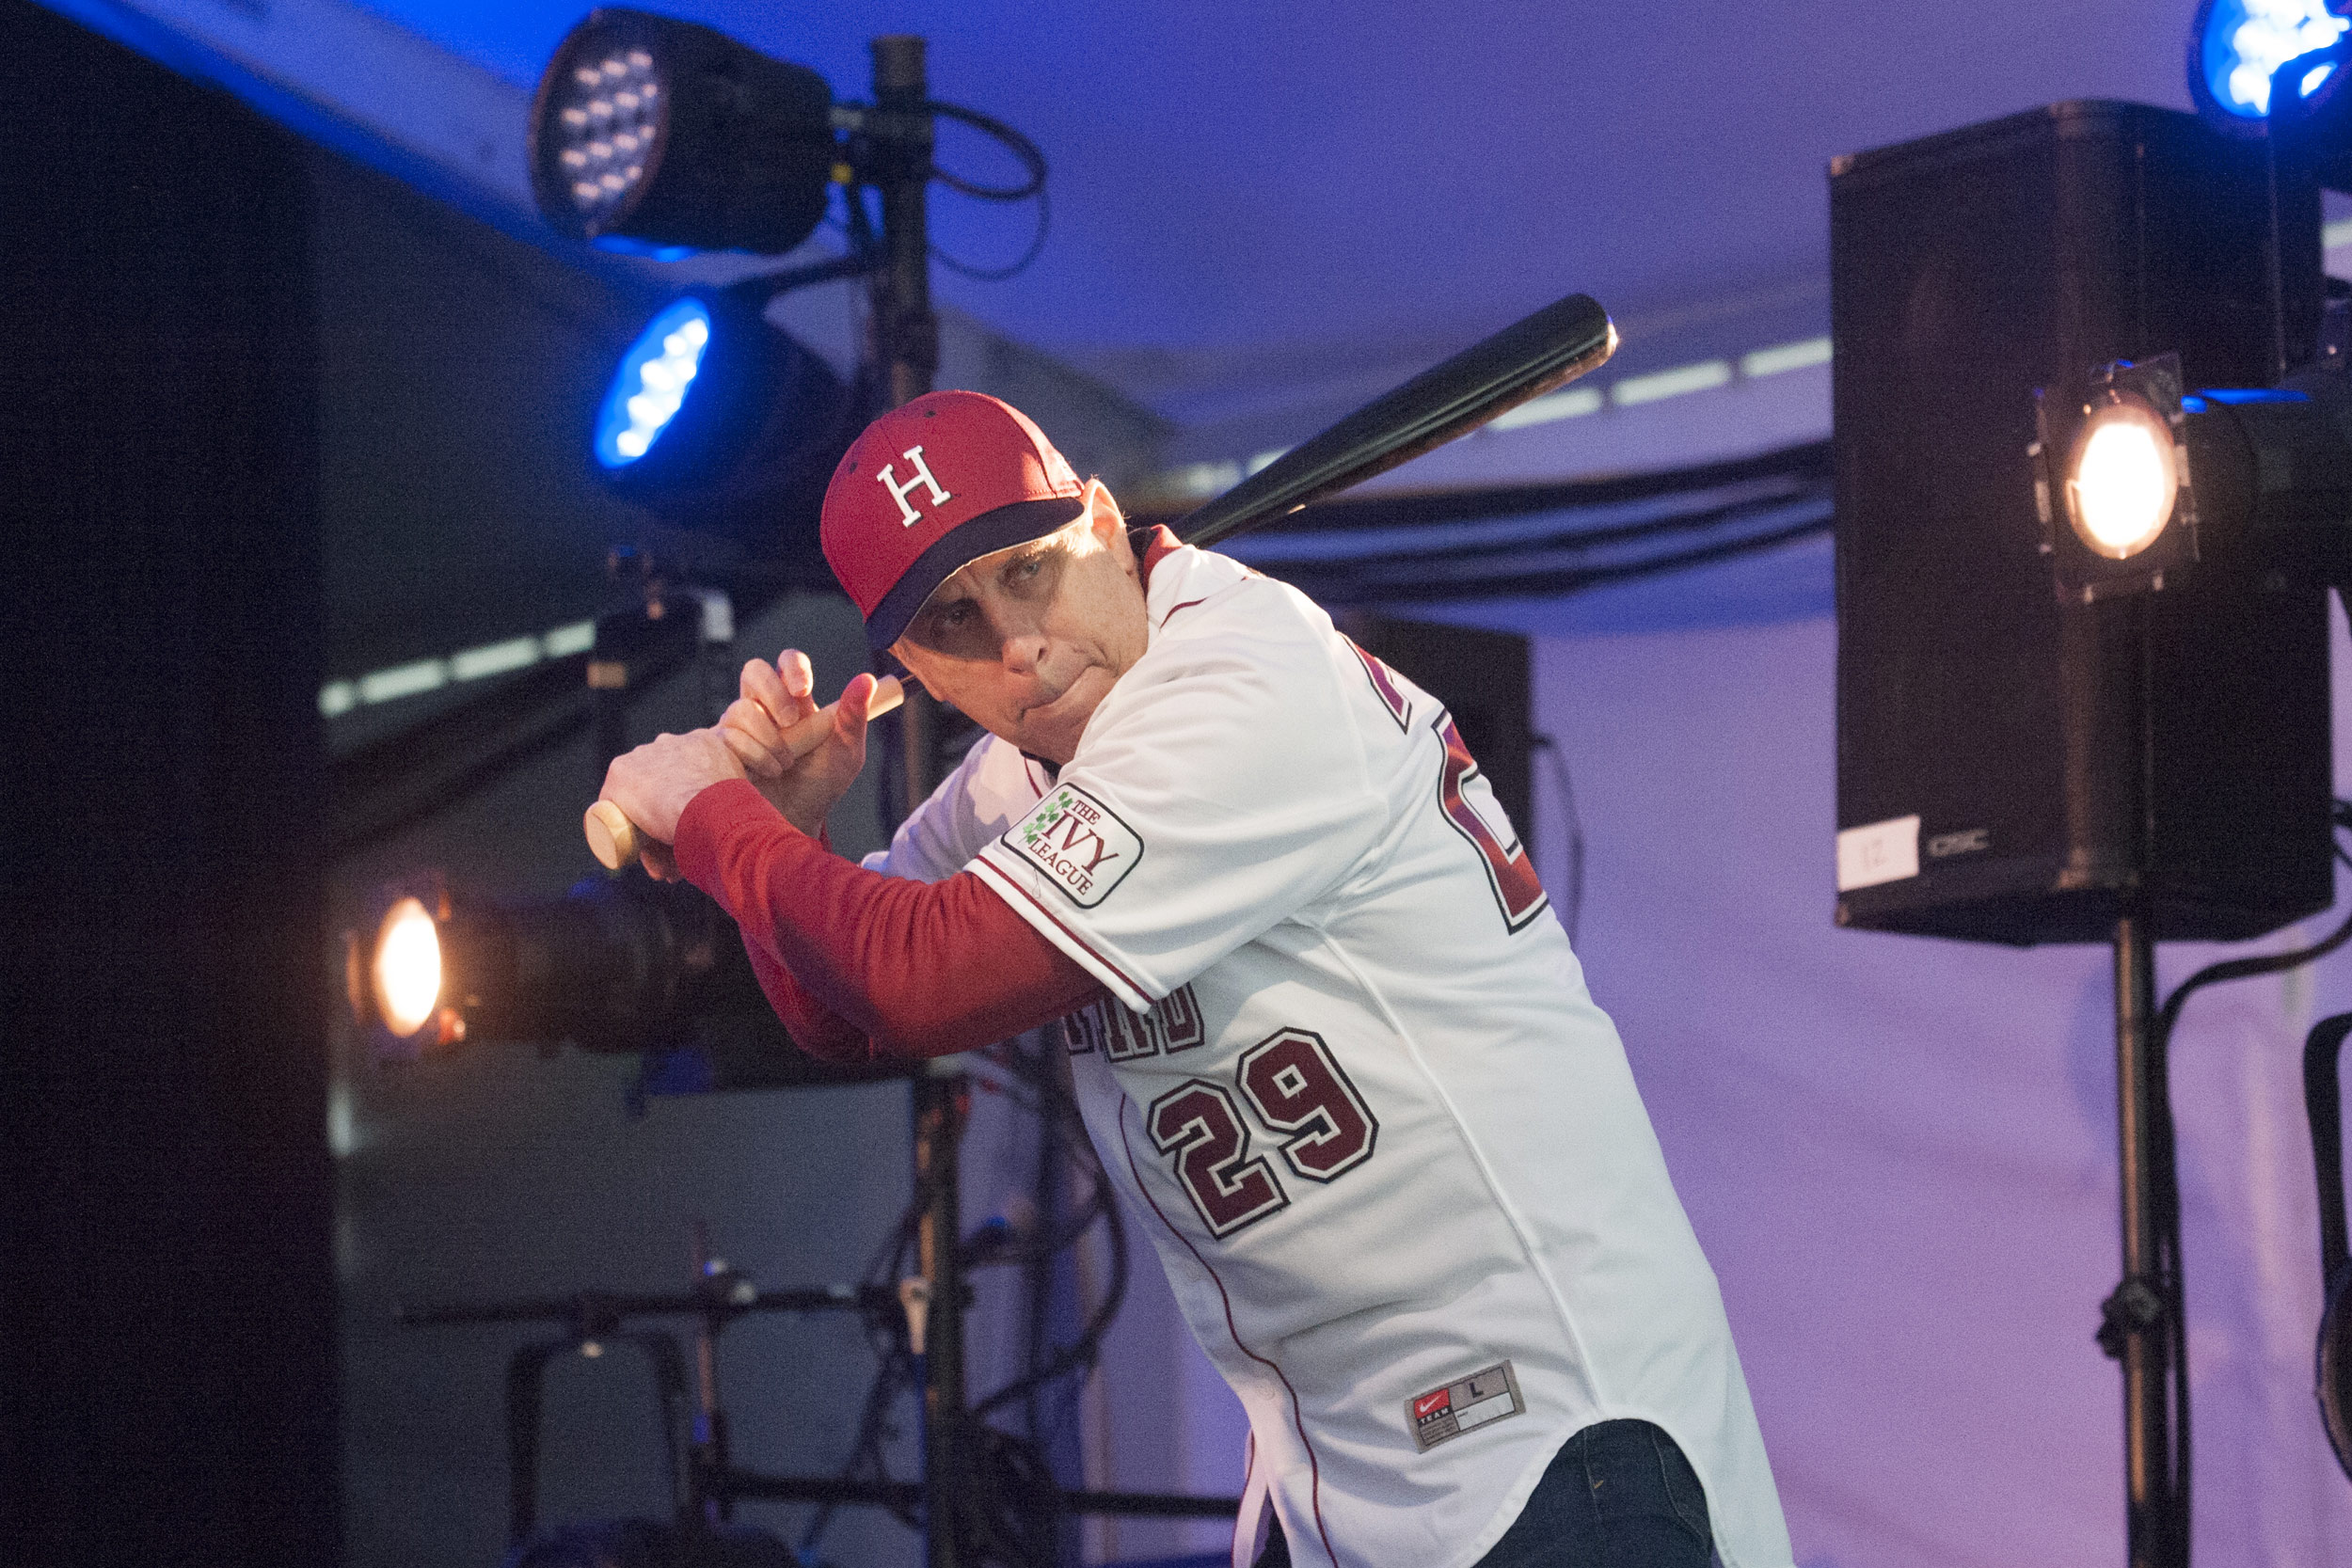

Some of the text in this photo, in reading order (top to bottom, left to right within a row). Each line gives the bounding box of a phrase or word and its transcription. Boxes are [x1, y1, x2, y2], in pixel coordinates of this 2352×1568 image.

[876, 445, 951, 528] H
[1071, 800, 1102, 826] THE
[1028, 837, 1093, 895] LEAGUE
[1041, 810, 1120, 877] IVY
[1147, 1026, 1380, 1241] 29
[1420, 1407, 1450, 1425] TEAM
[1469, 1382, 1485, 1399] L
